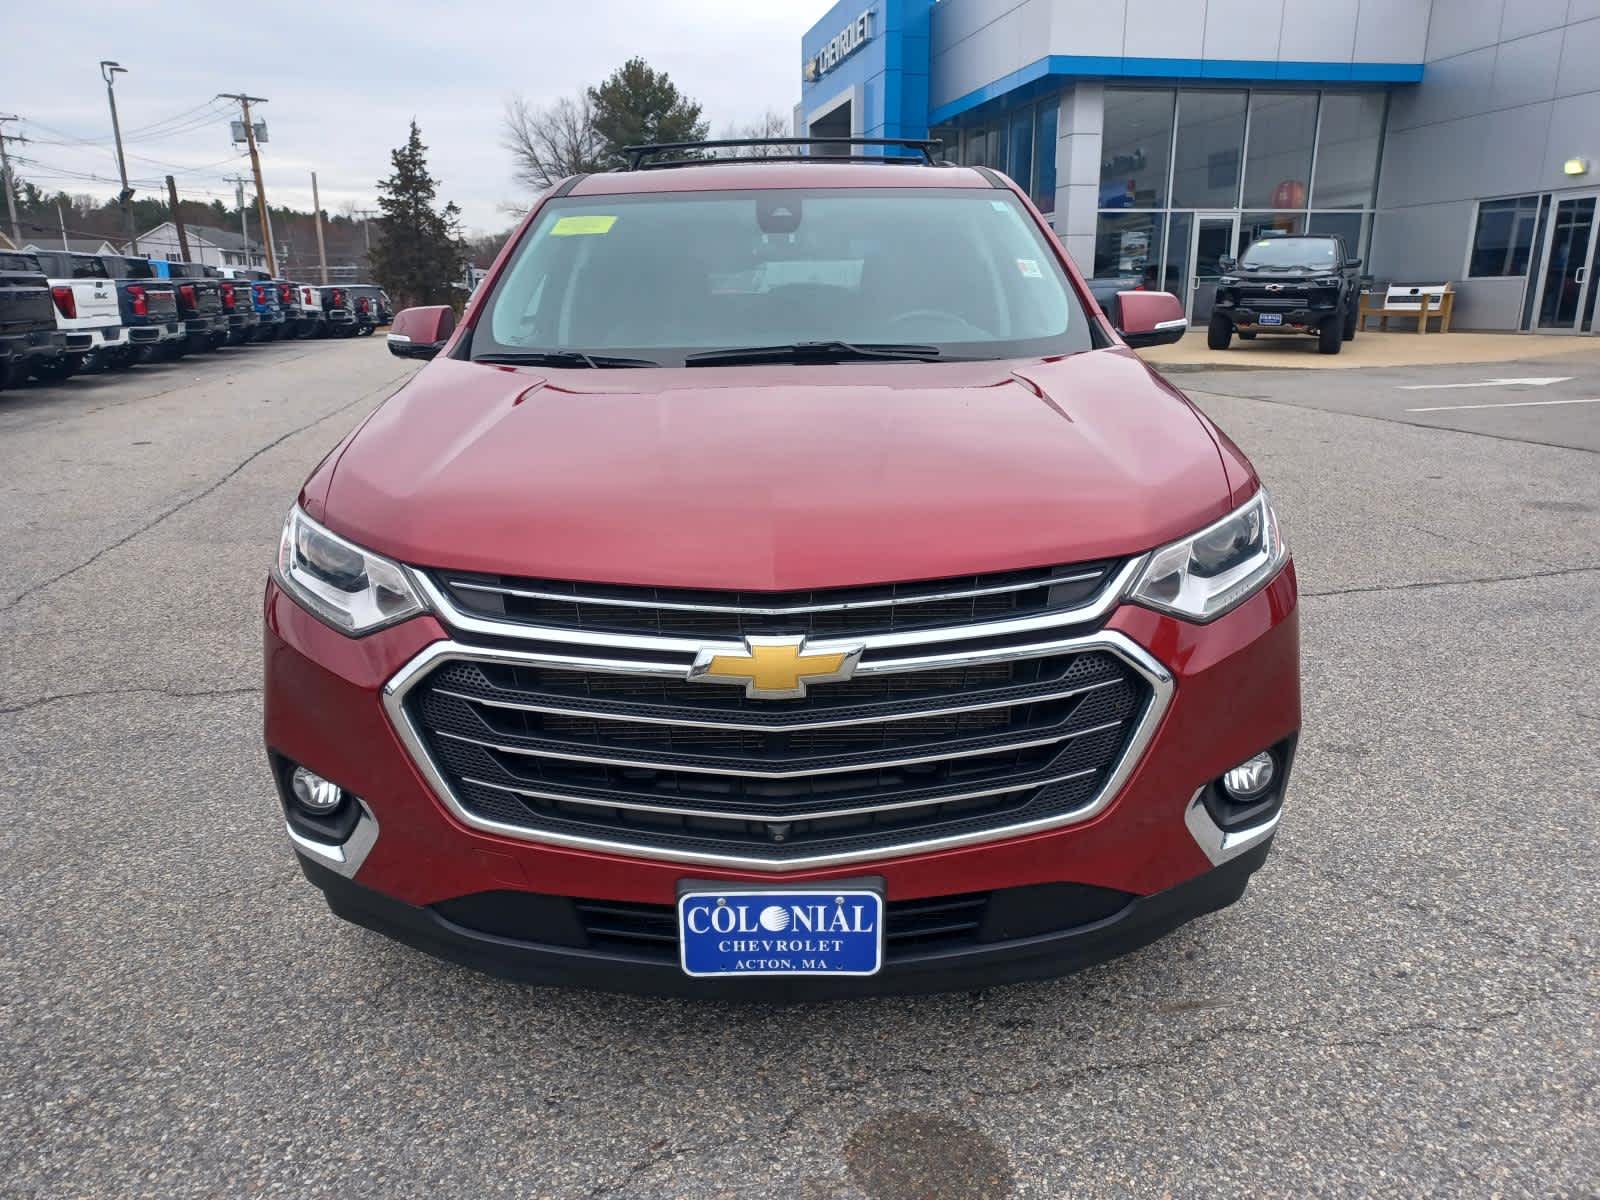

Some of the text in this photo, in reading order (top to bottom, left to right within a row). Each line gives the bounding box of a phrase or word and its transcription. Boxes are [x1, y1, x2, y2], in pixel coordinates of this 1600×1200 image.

[818, 8, 876, 74] CHEVROLET
[687, 905, 873, 933] COLONIAL
[718, 940, 843, 952] CHEVROLET
[735, 959, 828, 970] ACTON, MA
